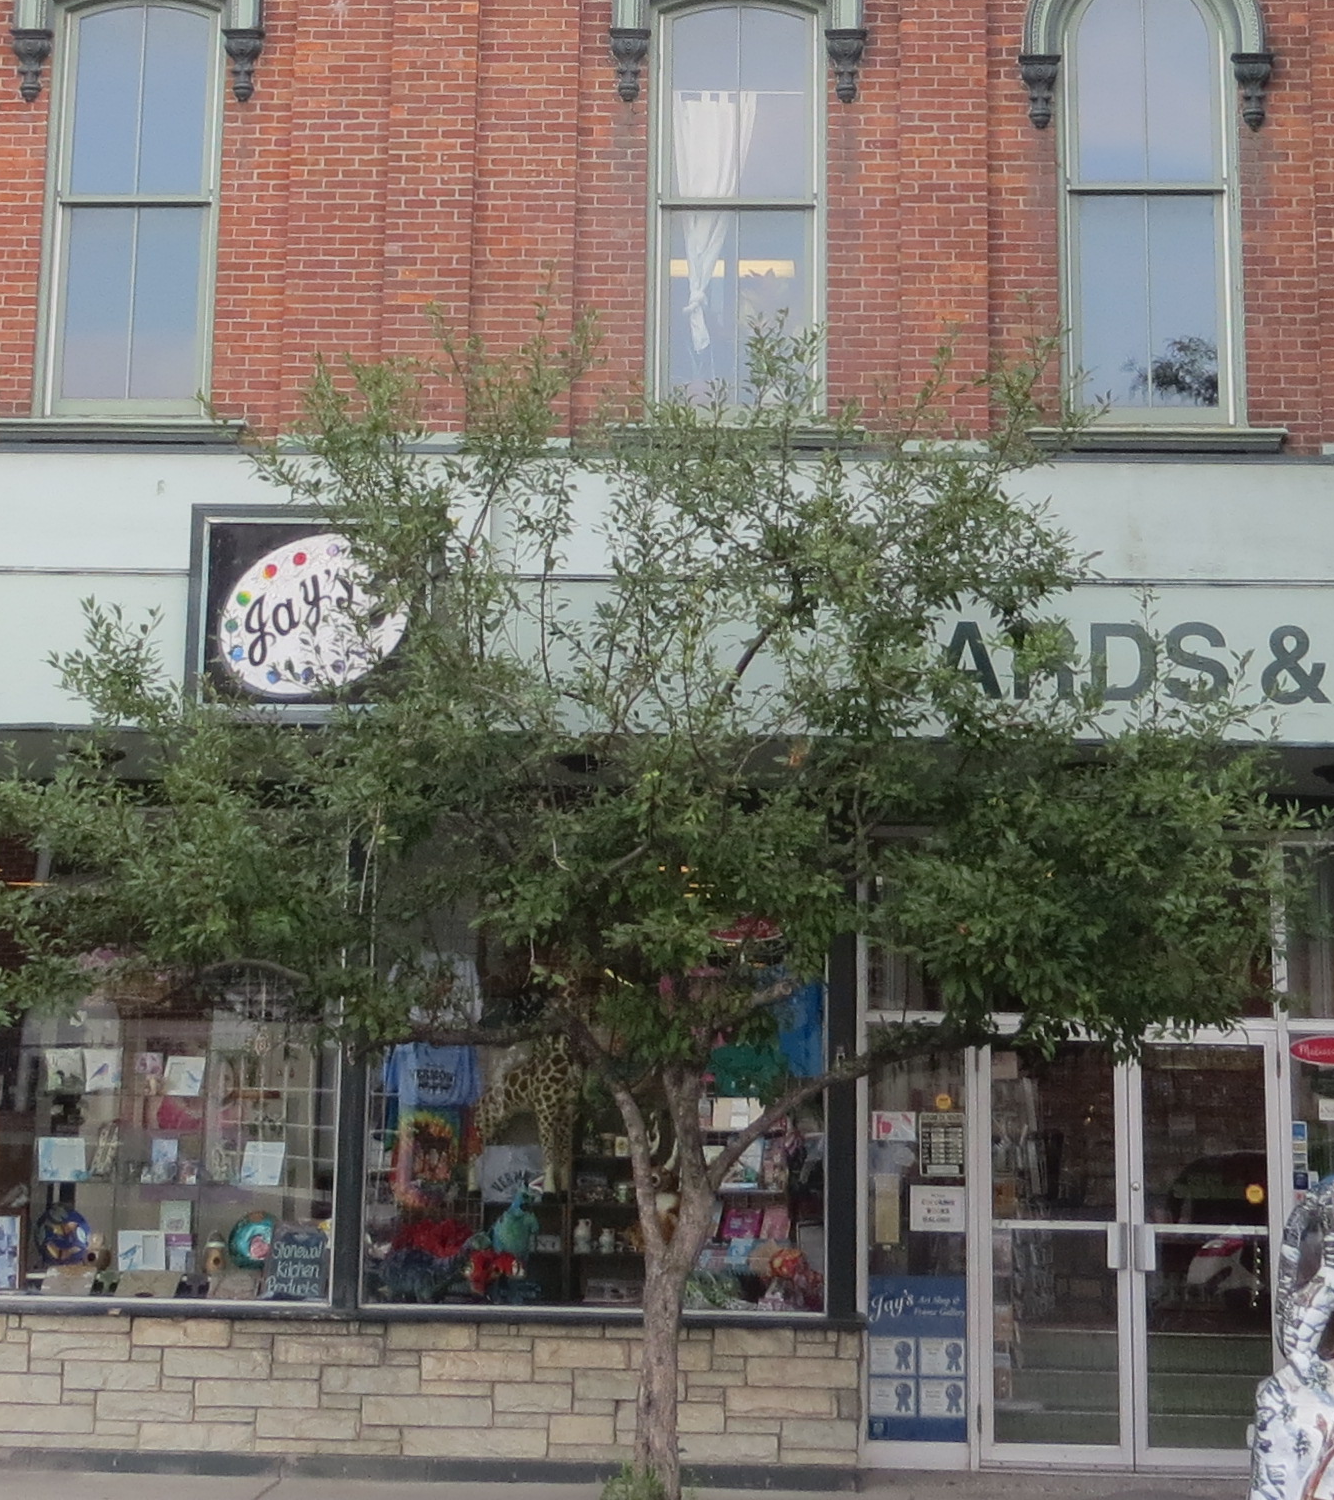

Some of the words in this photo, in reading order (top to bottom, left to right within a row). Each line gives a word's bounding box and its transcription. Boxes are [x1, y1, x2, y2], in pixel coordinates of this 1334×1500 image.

[937, 619, 1231, 705] ARDS
[1260, 624, 1329, 704] &
[869, 1289, 914, 1322] Jay's
